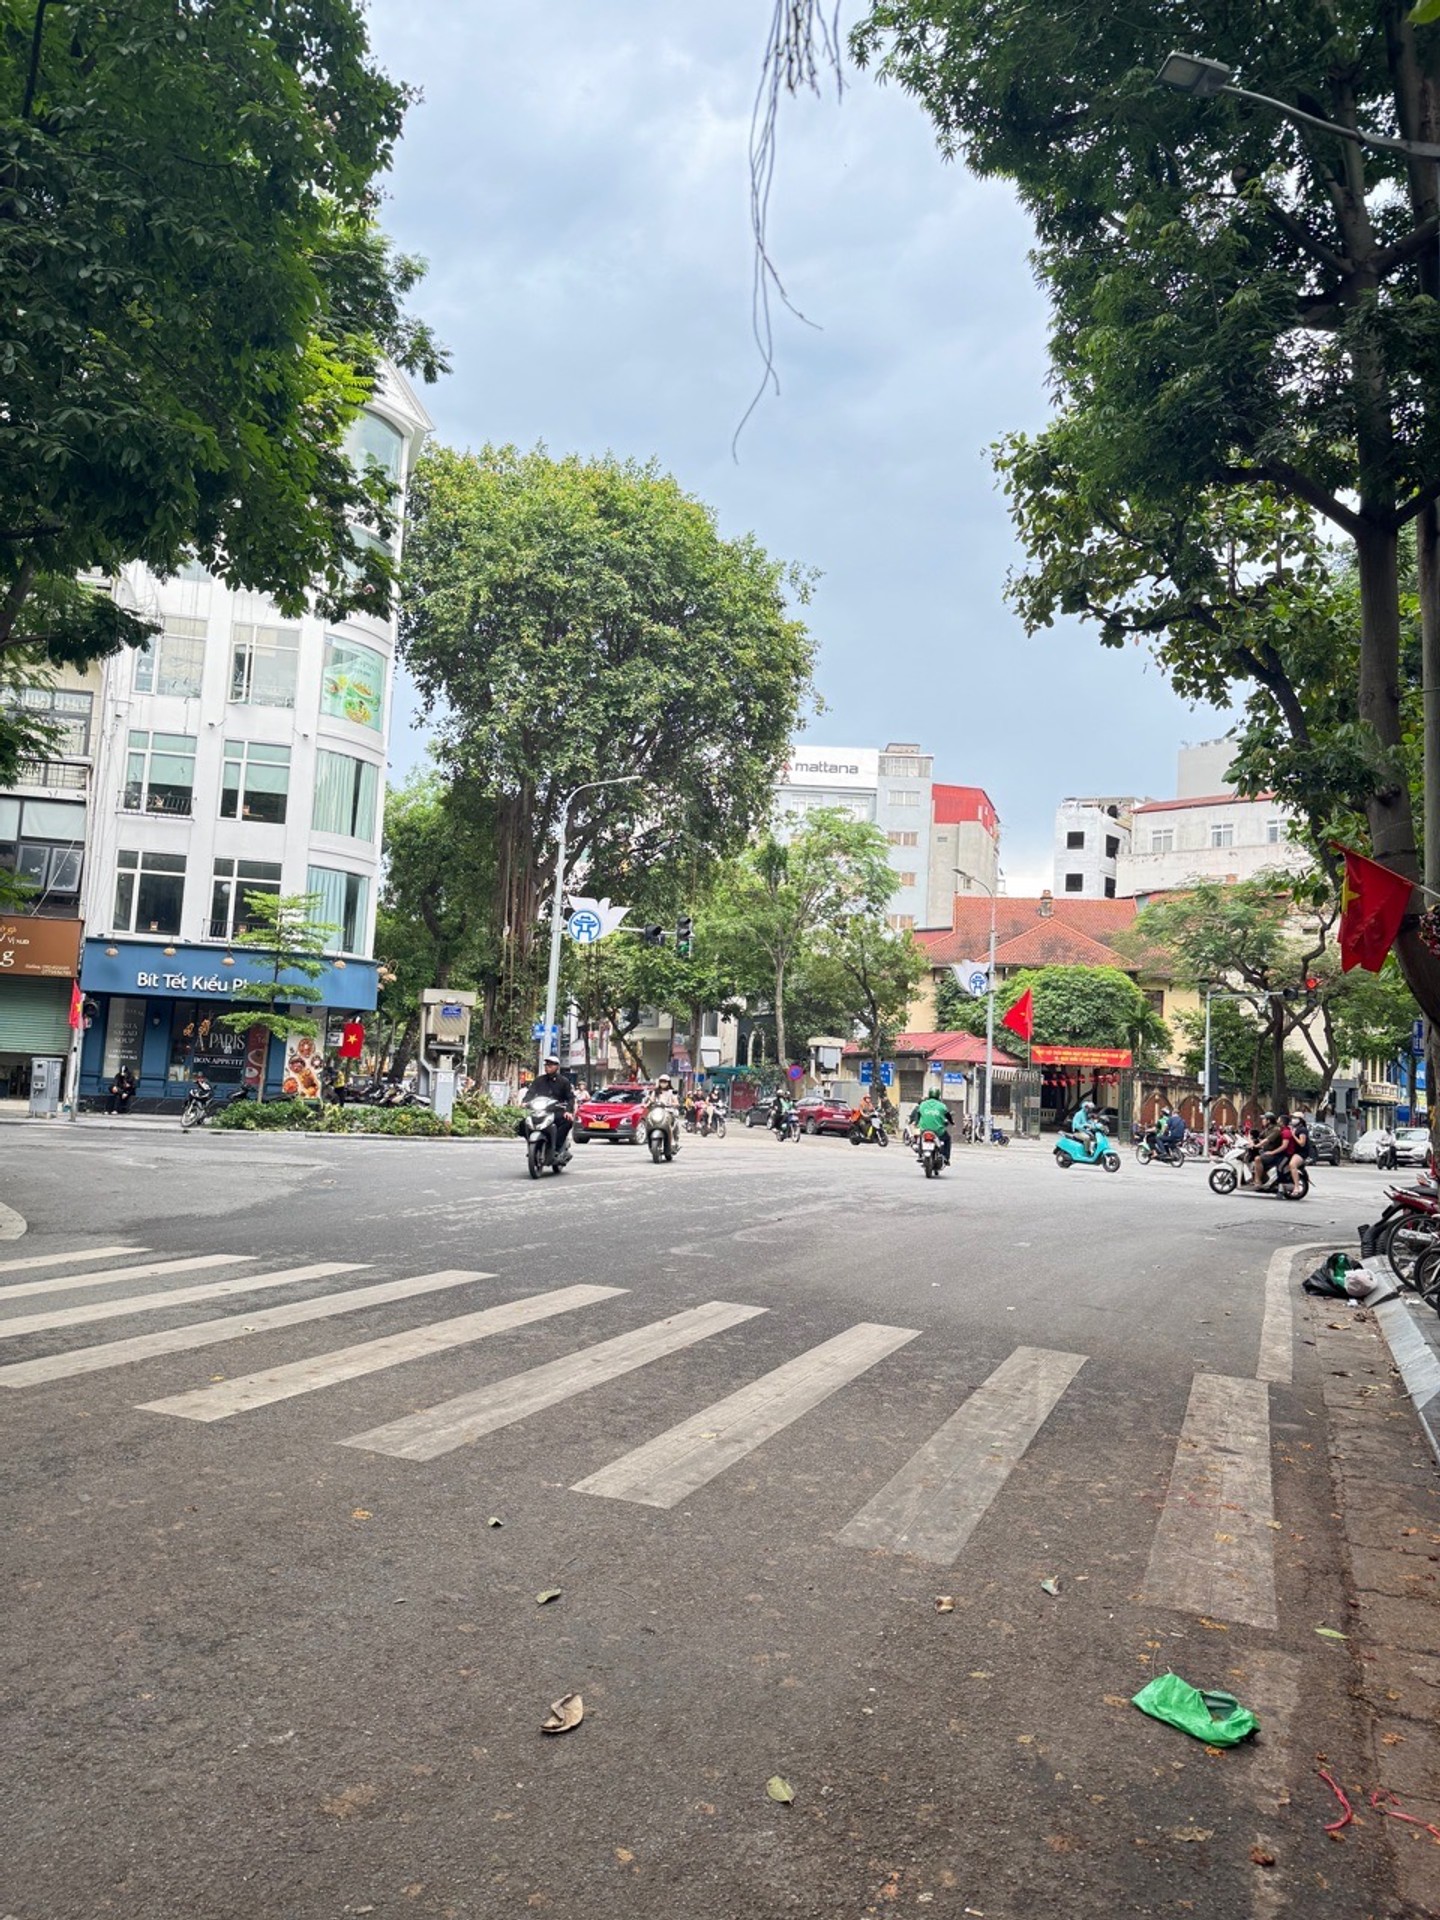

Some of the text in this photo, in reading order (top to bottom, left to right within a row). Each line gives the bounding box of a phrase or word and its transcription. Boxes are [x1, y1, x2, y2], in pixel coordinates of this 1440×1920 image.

[795, 761, 859, 774] mattana
[137, 972, 159, 987] Bít
[163, 971, 188, 989] Tết
[192, 974, 228, 992] Kiểu
[208, 1033, 246, 1050] PARIS
[193, 1056, 211, 1064] BON
[924, 1108, 940, 1117] Grab
